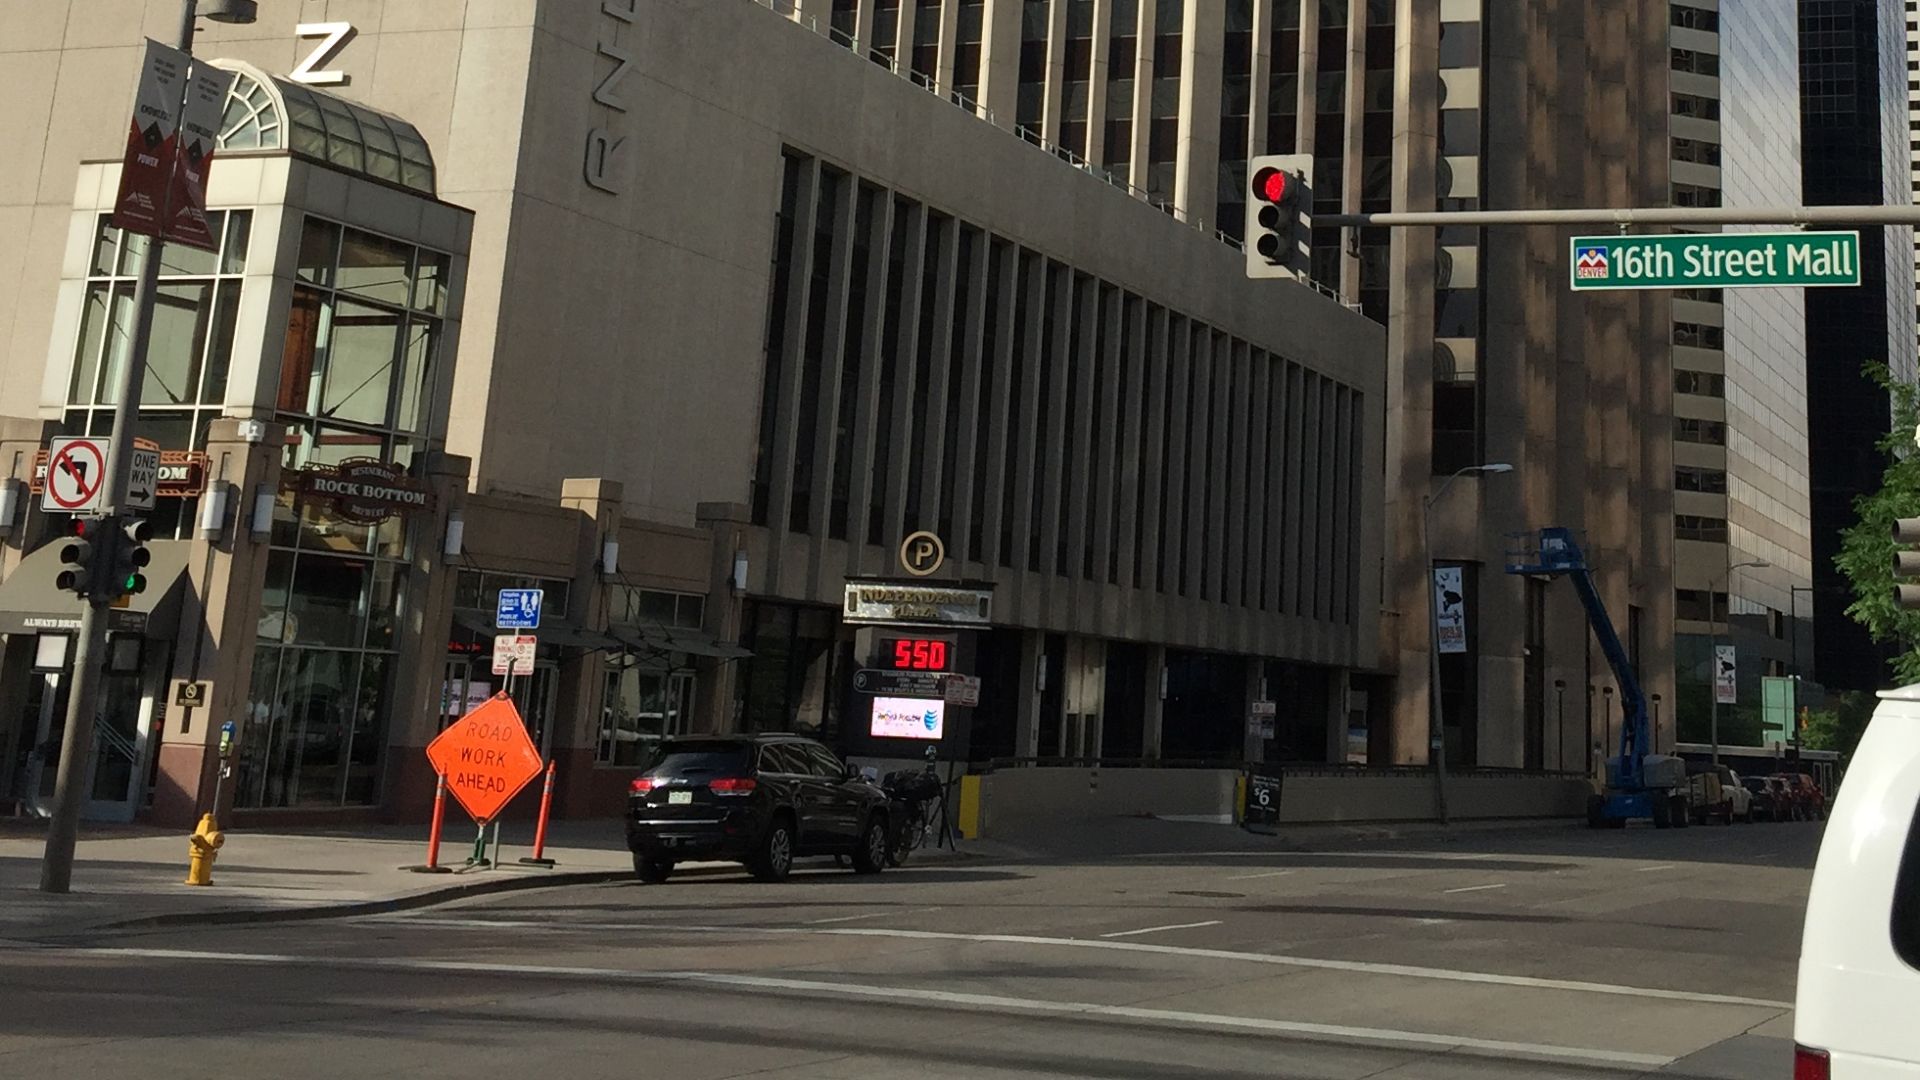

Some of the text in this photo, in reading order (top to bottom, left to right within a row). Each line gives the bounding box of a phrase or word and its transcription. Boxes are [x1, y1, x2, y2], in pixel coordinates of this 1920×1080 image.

[1611, 240, 1853, 279] 16th Street Mall
[1577, 268, 1608, 278] DENVER
[134, 453, 156, 469] ONE
[131, 470, 155, 486] WAY
[351, 466, 396, 482] RESTAURANT
[314, 478, 426, 505] ROCK BOTTOM
[915, 542, 934, 566] P
[895, 640, 945, 669] 550
[466, 722, 513, 742] ROAD
[461, 747, 508, 768] WORK
[456, 772, 506, 793] AHEAD
